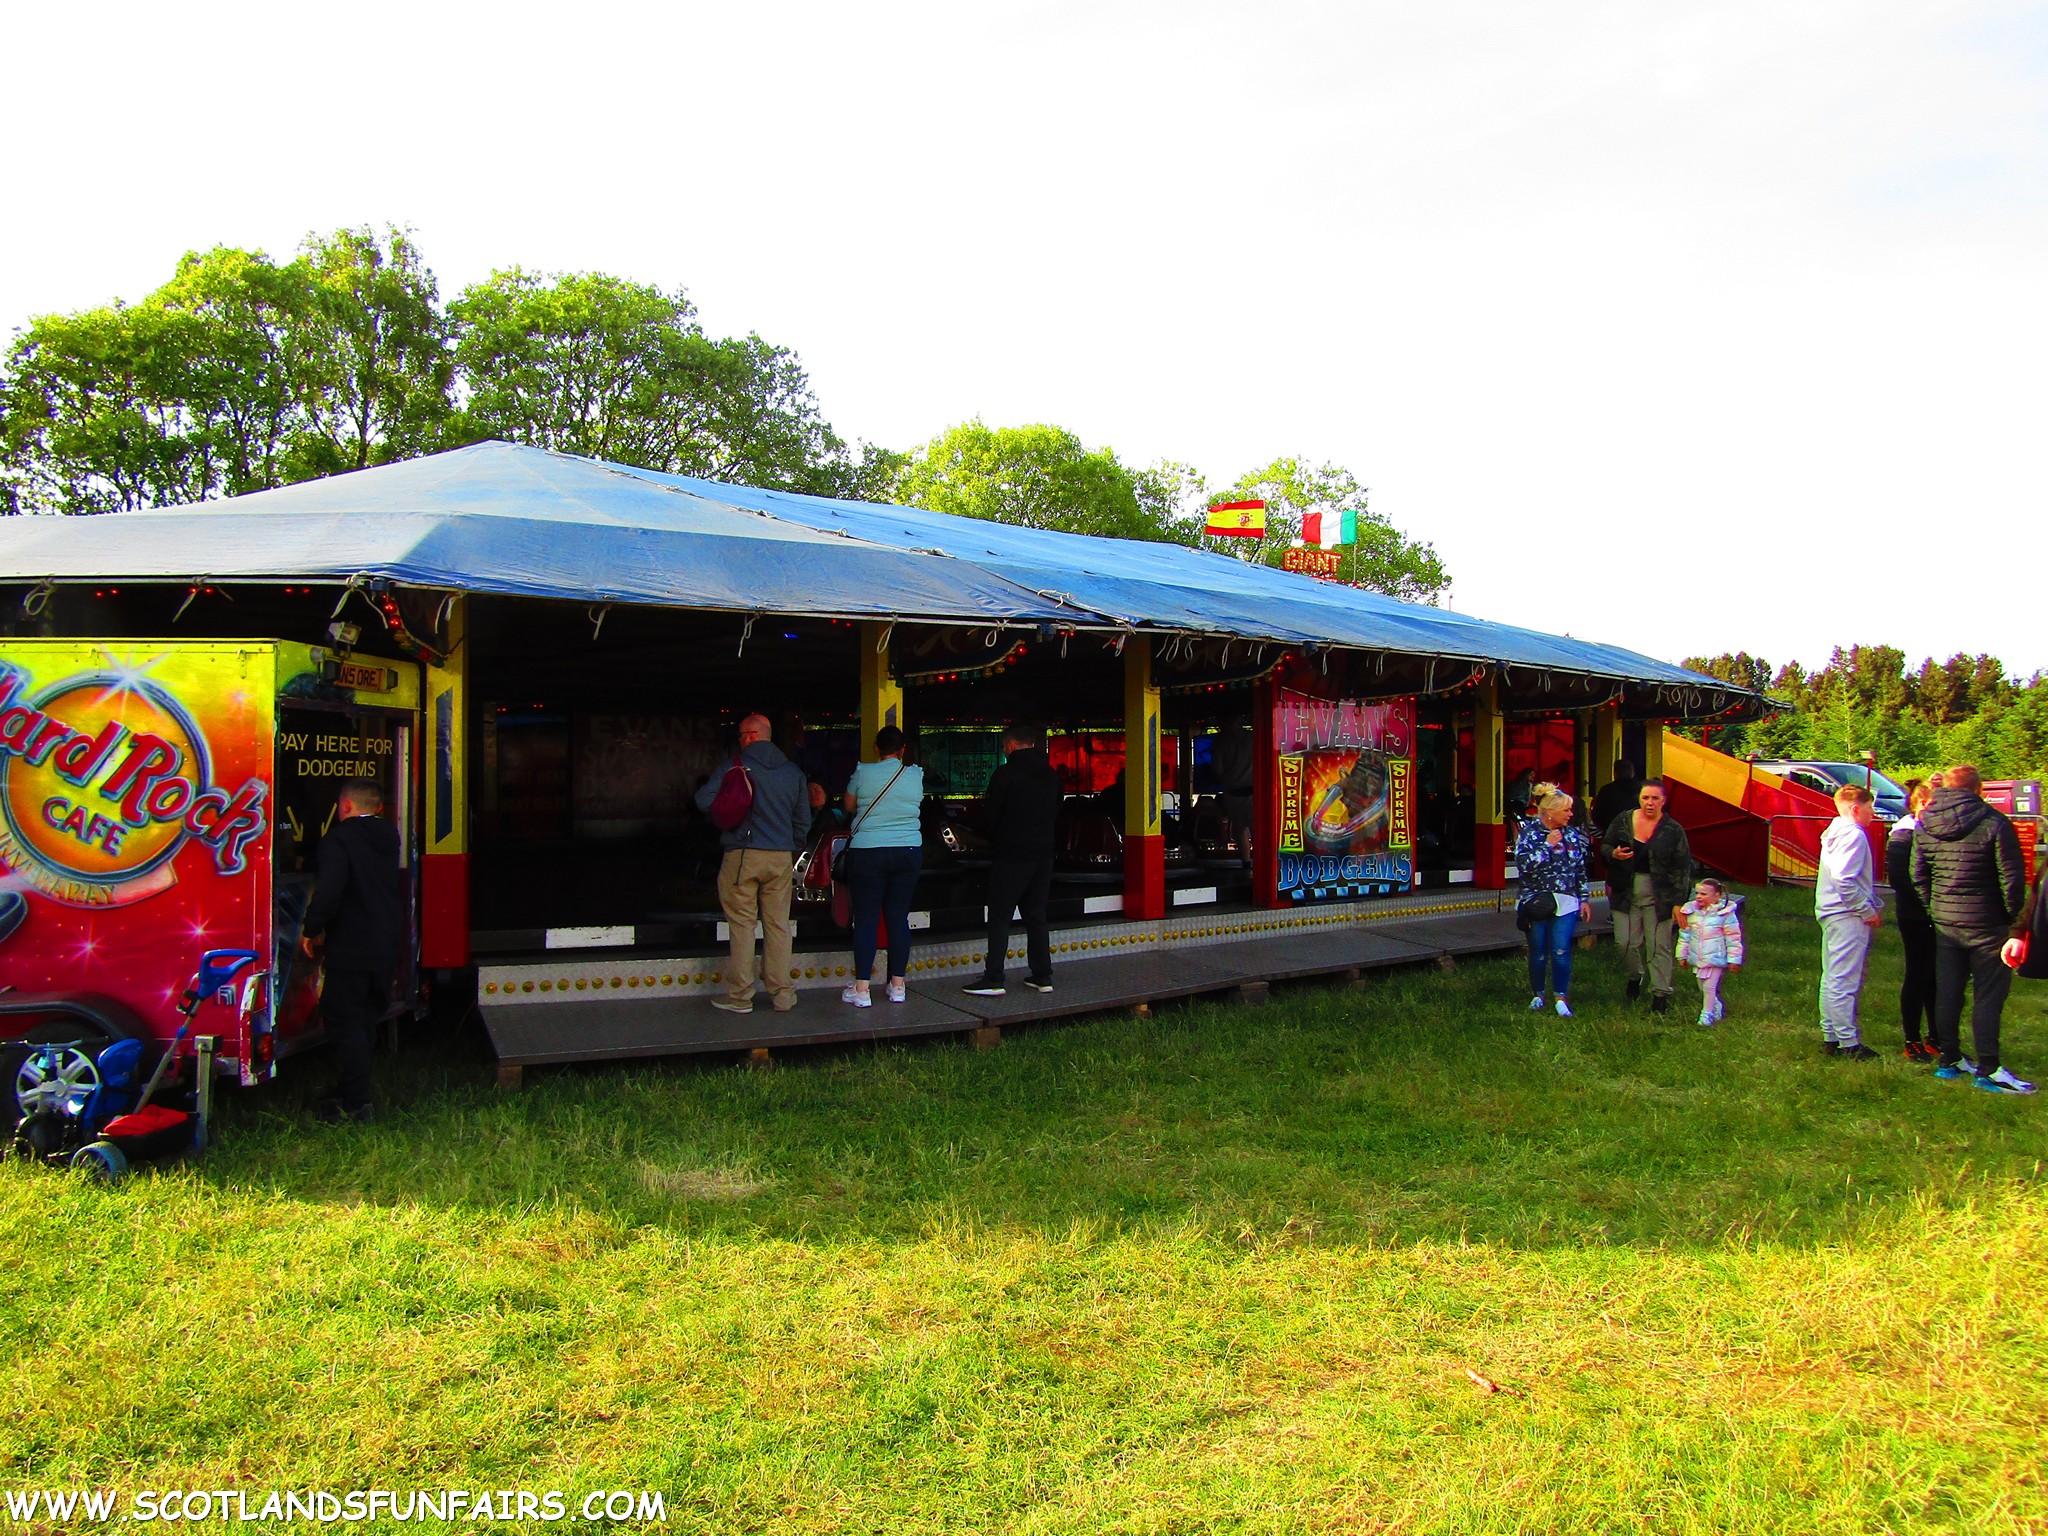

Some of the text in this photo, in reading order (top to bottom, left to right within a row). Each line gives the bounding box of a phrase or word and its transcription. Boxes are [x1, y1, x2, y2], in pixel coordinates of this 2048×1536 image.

[1285, 551, 1342, 573] GIANT
[316, 735, 360, 753] HERE
[366, 738, 393, 755] FOR
[589, 716, 713, 740] EVANS
[1280, 687, 1410, 758] EVANS
[0, 664, 268, 874] ard Rock
[298, 759, 376, 777] DODGEMS
[42, 796, 129, 857] CAFE
[1283, 760, 1300, 847] SUPREME
[1393, 763, 1406, 846] SUPREME
[1278, 850, 1411, 891] DODGEMS
